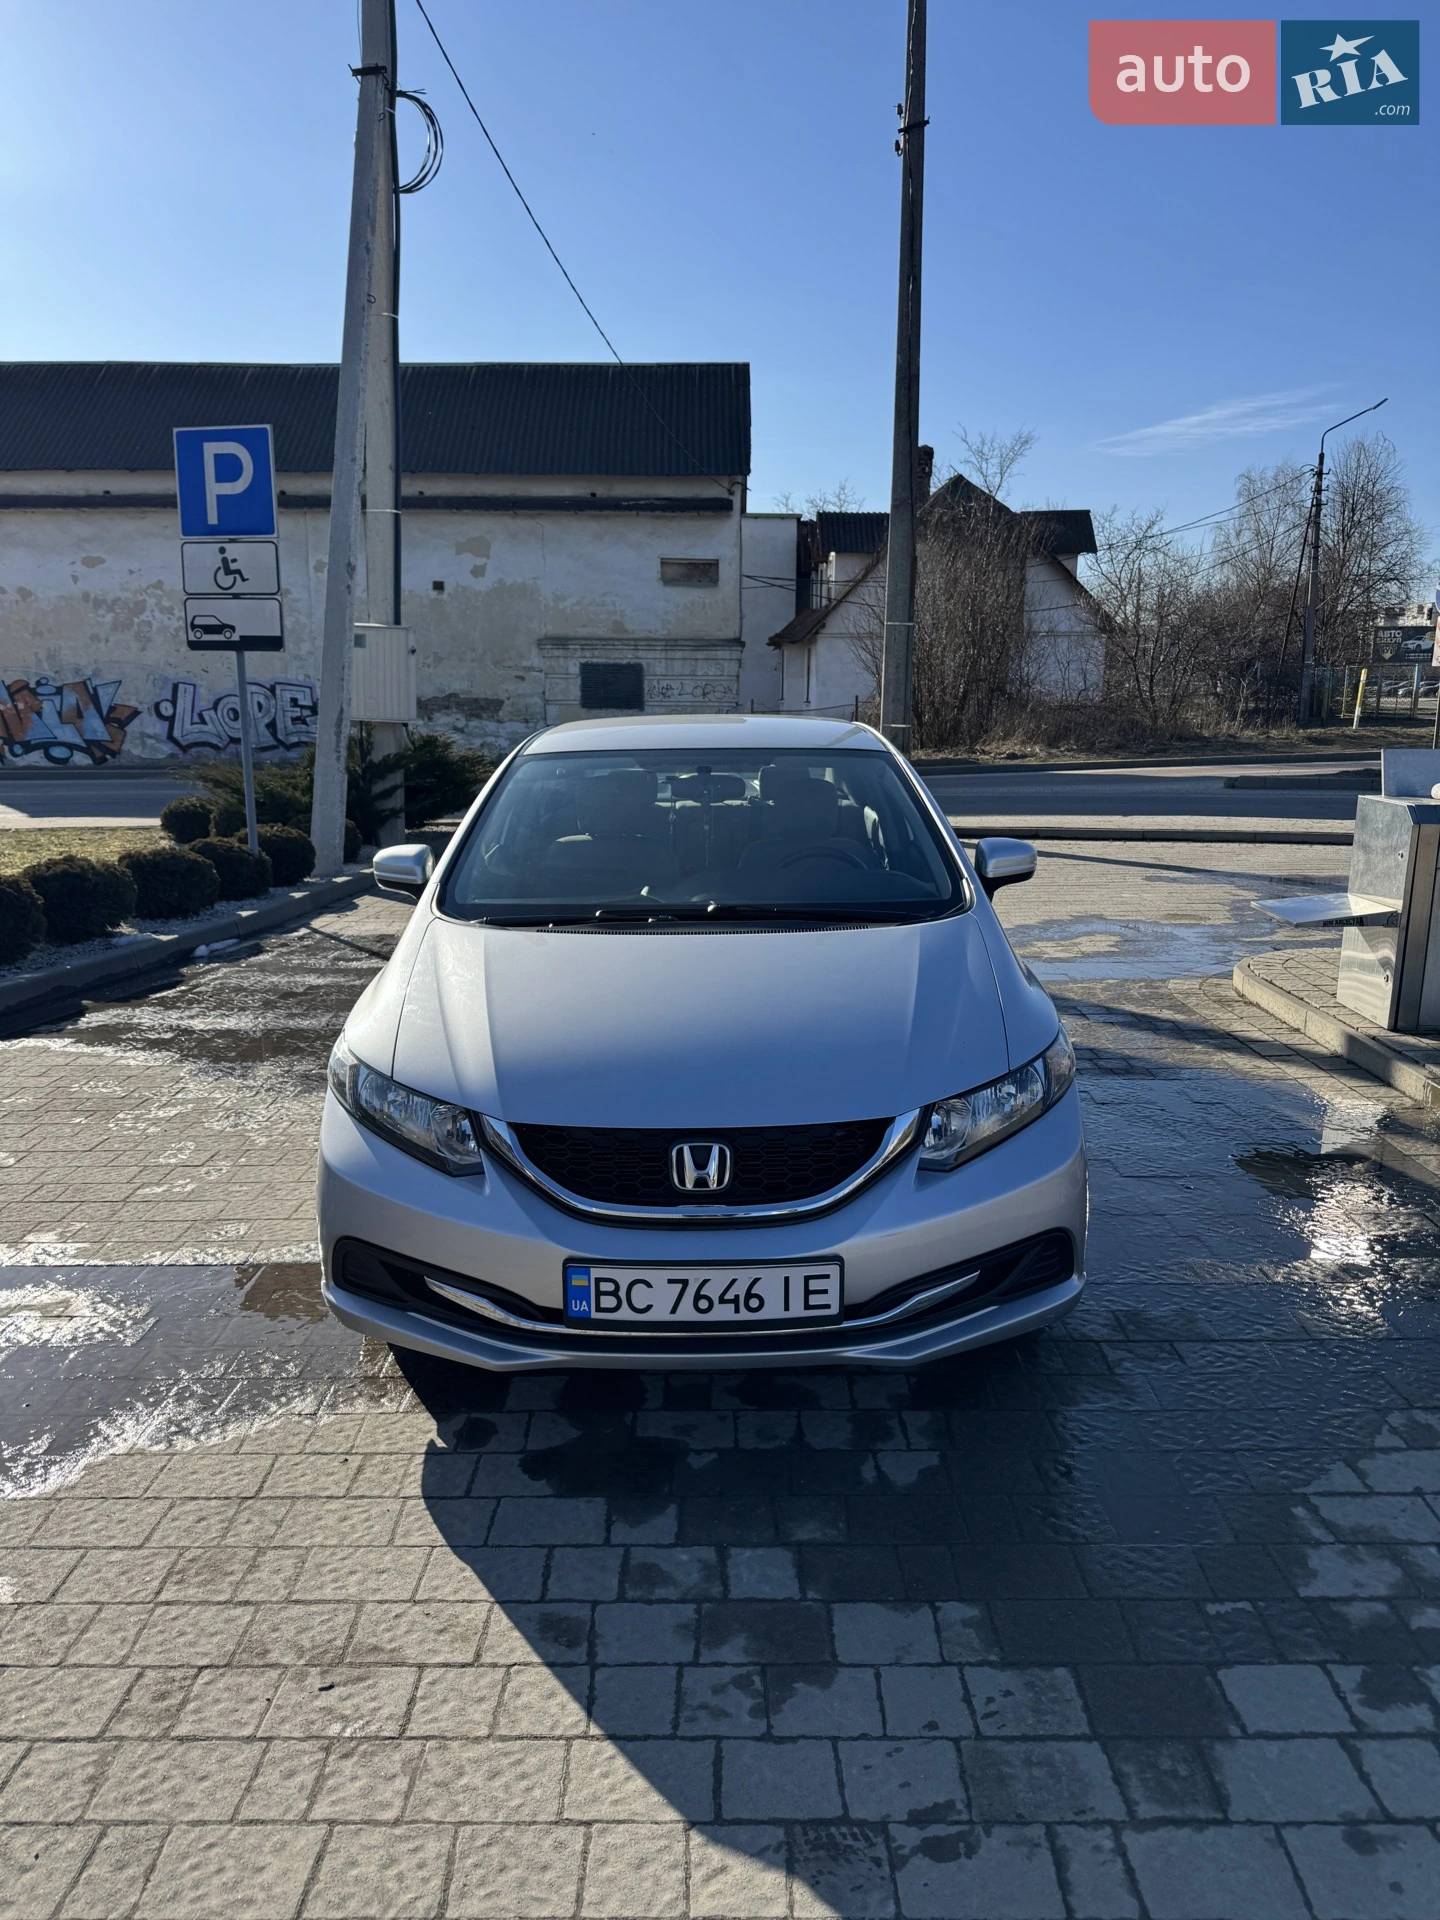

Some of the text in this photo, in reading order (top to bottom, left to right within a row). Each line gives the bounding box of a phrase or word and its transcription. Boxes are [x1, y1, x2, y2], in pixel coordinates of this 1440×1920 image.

[203, 441, 254, 525] P
[571, 1299, 589, 1312] UA
[594, 1273, 832, 1315] BC 7646 IE
